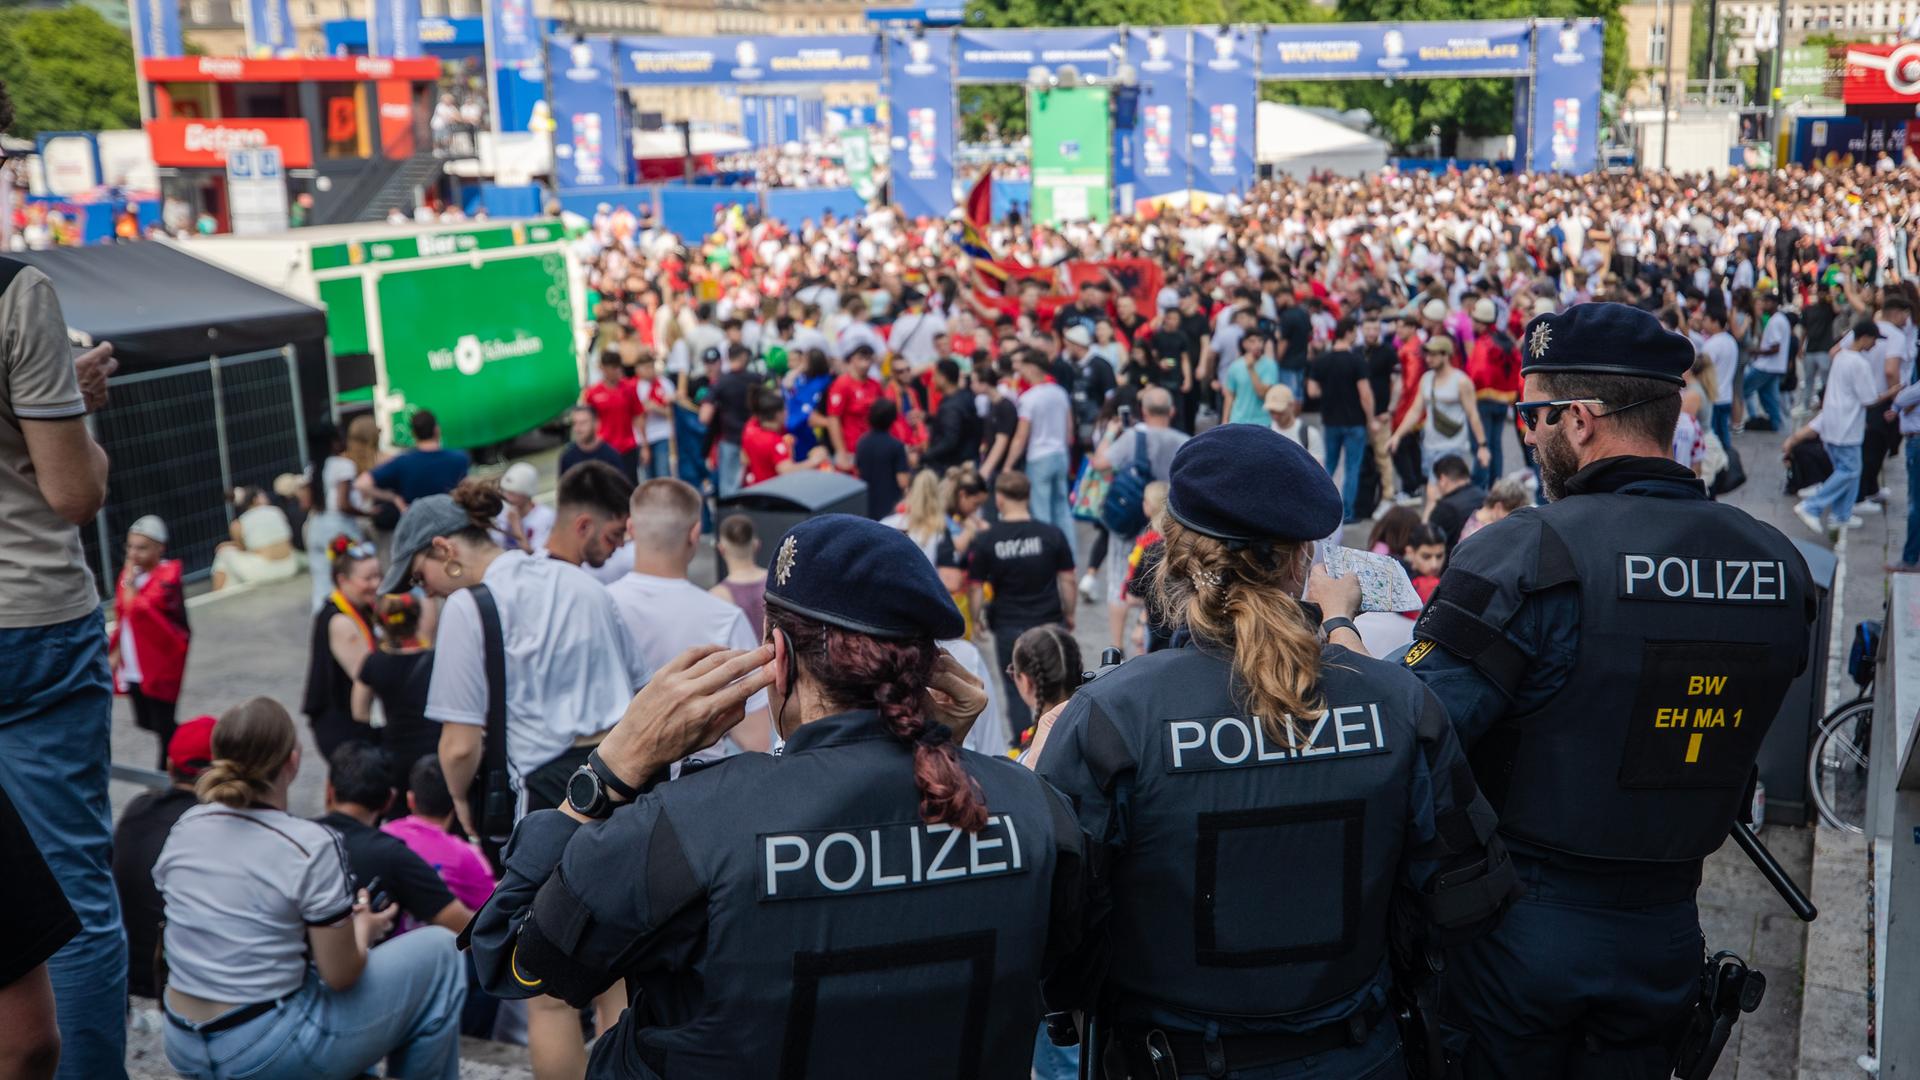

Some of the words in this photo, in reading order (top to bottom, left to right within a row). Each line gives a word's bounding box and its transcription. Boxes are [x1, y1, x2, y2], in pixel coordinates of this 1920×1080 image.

[994, 537, 1043, 560] GASHI
[1624, 555, 1786, 600] POLIZEI
[1687, 675, 1728, 695] BW
[1654, 708, 1689, 728] EH
[1692, 708, 1725, 728] MA
[1733, 708, 1743, 728] 1
[1170, 703, 1385, 768] POLIZEI
[765, 814, 1023, 896] POLIZEI
